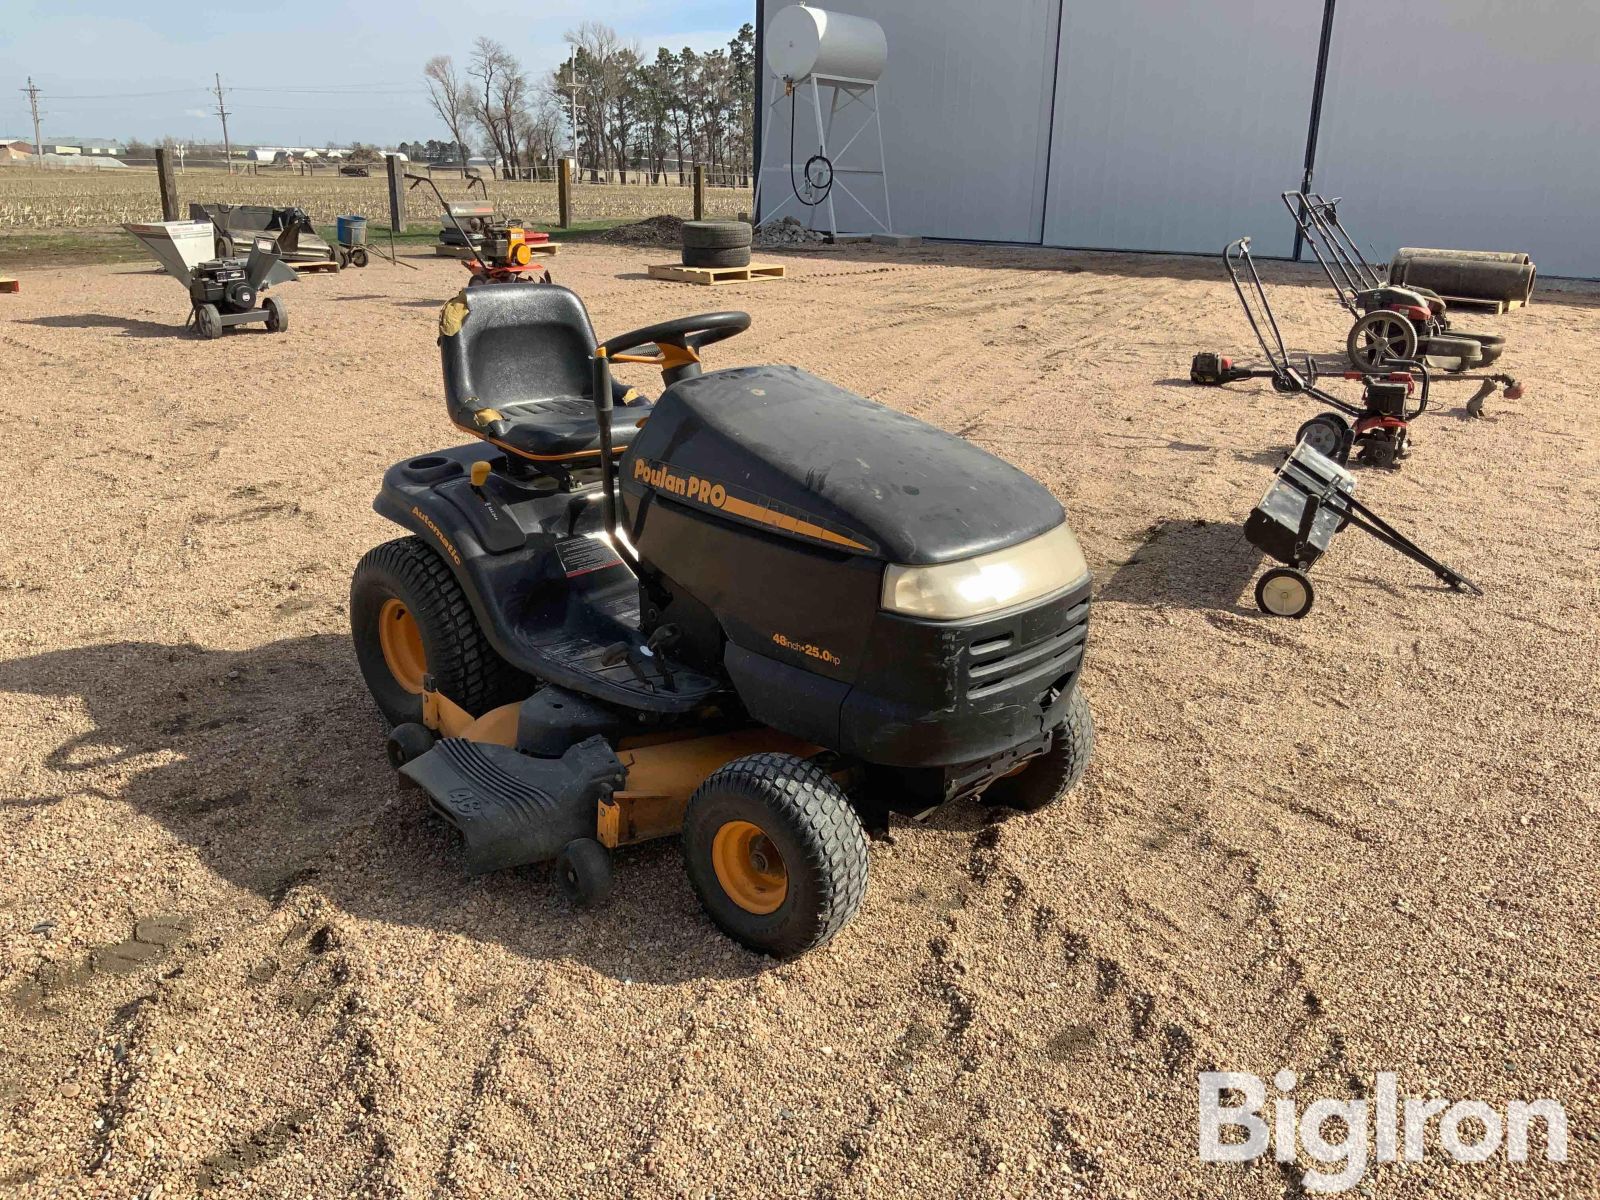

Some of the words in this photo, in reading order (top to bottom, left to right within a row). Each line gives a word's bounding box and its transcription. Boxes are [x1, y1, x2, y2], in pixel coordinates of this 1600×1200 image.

[634, 458, 686, 496] Poulan
[687, 475, 726, 508] PRO
[412, 506, 461, 566] Automatic
